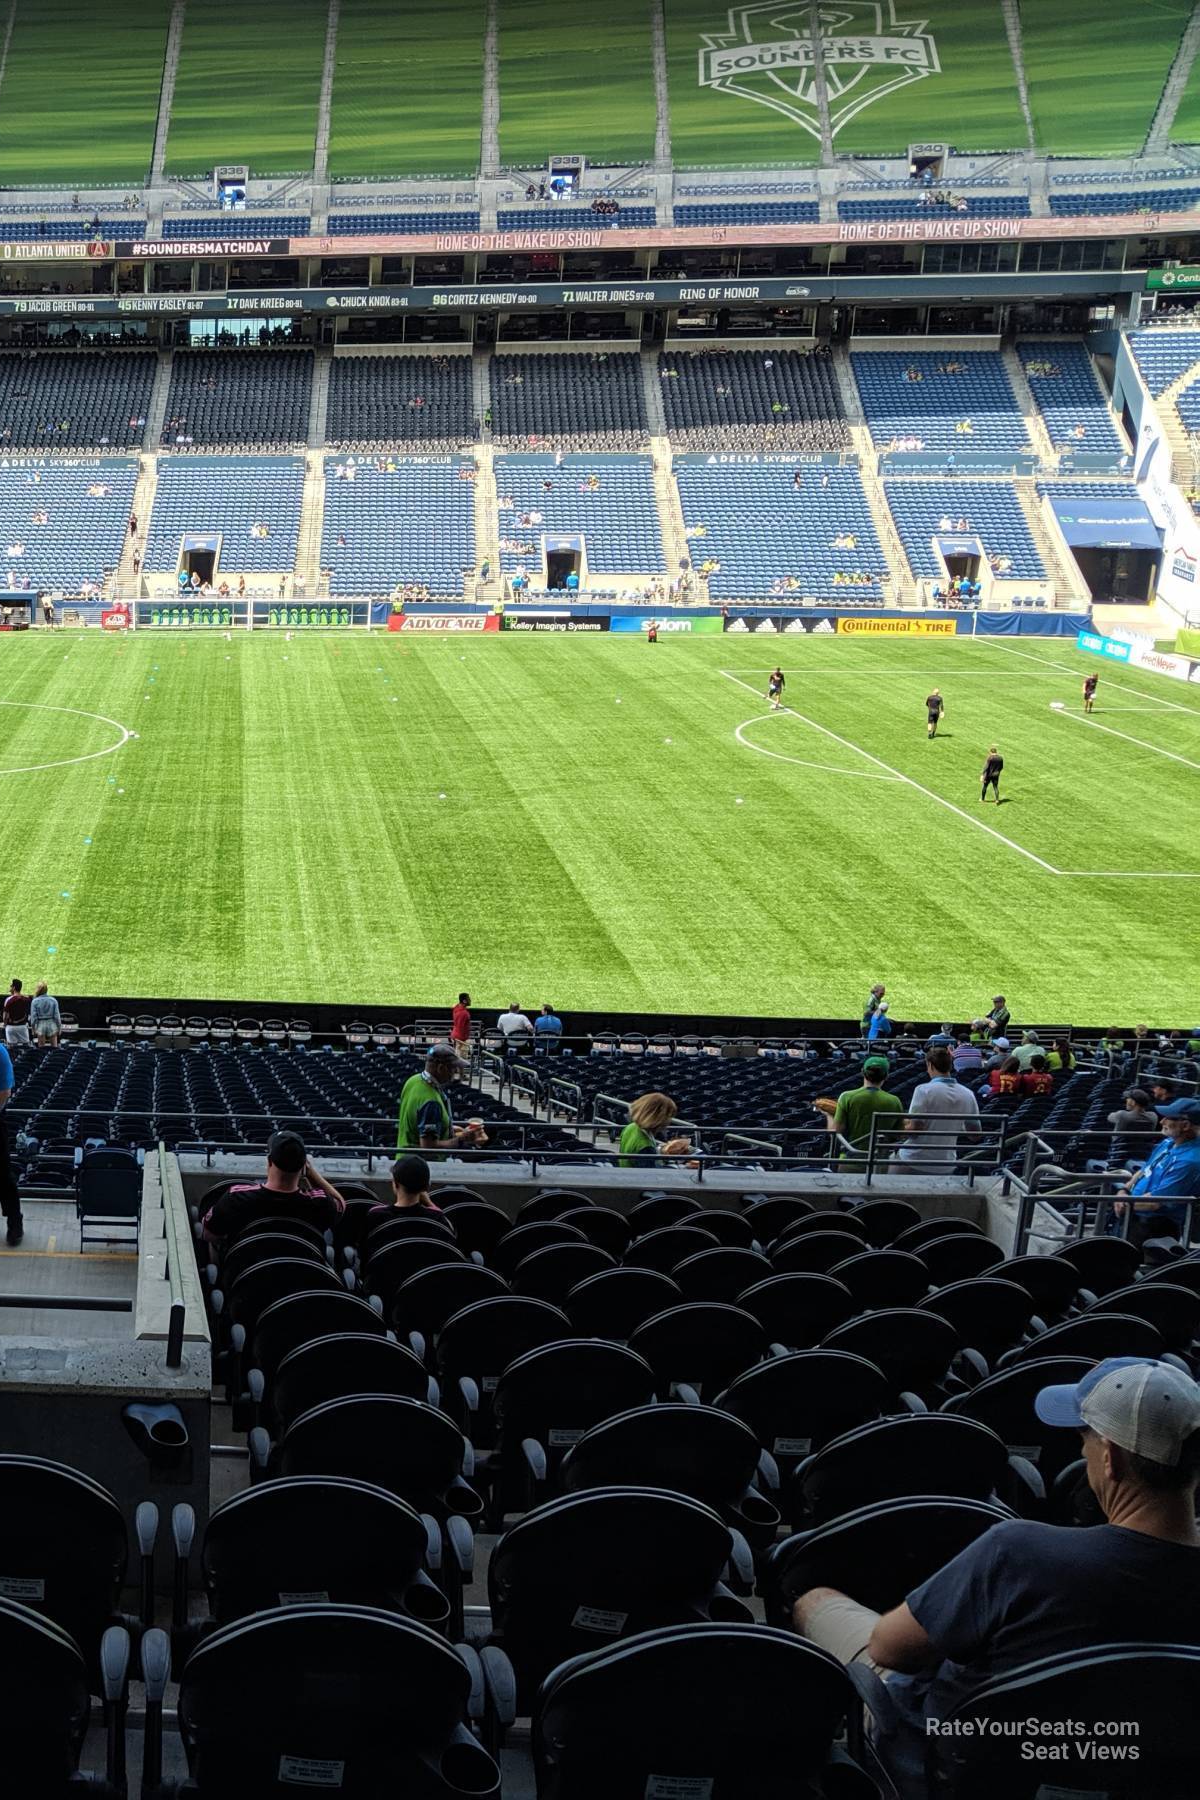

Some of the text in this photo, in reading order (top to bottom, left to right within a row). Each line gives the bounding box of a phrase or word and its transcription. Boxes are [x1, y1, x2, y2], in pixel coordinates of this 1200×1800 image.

[760, 40, 870, 52] SEATLE
[884, 49, 922, 61] FC
[553, 156, 580, 164] 338
[839, 220, 1022, 240] HOME OF THE WAKE UP SHOW
[436, 232, 602, 250] HOME OF THE WAKE UP SHOW
[4, 246, 12, 259] 0
[15, 244, 54, 257] ATLANTA
[55, 244, 86, 257] UNITED
[132, 242, 272, 255] #SOUNDERSMATCHDAY
[1177, 274, 1200, 283] Cent
[433, 295, 448, 305] 96
[448, 294, 478, 305] CORTEZ
[480, 293, 517, 304] KENNEDY
[562, 292, 574, 302] 71
[576, 291, 608, 302] WALTER
[608, 290, 636, 302] JONES
[679, 287, 759, 300] RING OF HONOR
[14, 302, 27, 312] 79
[28, 302, 52, 312] JACOB
[52, 302, 77, 312] GREEN
[118, 301, 132, 310] 45
[132, 300, 158, 310] KENNY
[159, 300, 187, 310] EASLEY
[227, 299, 239, 309] 17
[240, 298, 259, 310] DAVE
[260, 298, 285, 309] KRIEG
[340, 297, 368, 308] CHUCK
[369, 296, 390, 307] KNOX
[404, 618, 484, 628] ADVOCARE
[510, 622, 601, 632] Kelley Imaging Systems
[641, 618, 692, 631] salom
[842, 618, 910, 633] Continental
[924, 623, 952, 632] TIRE
